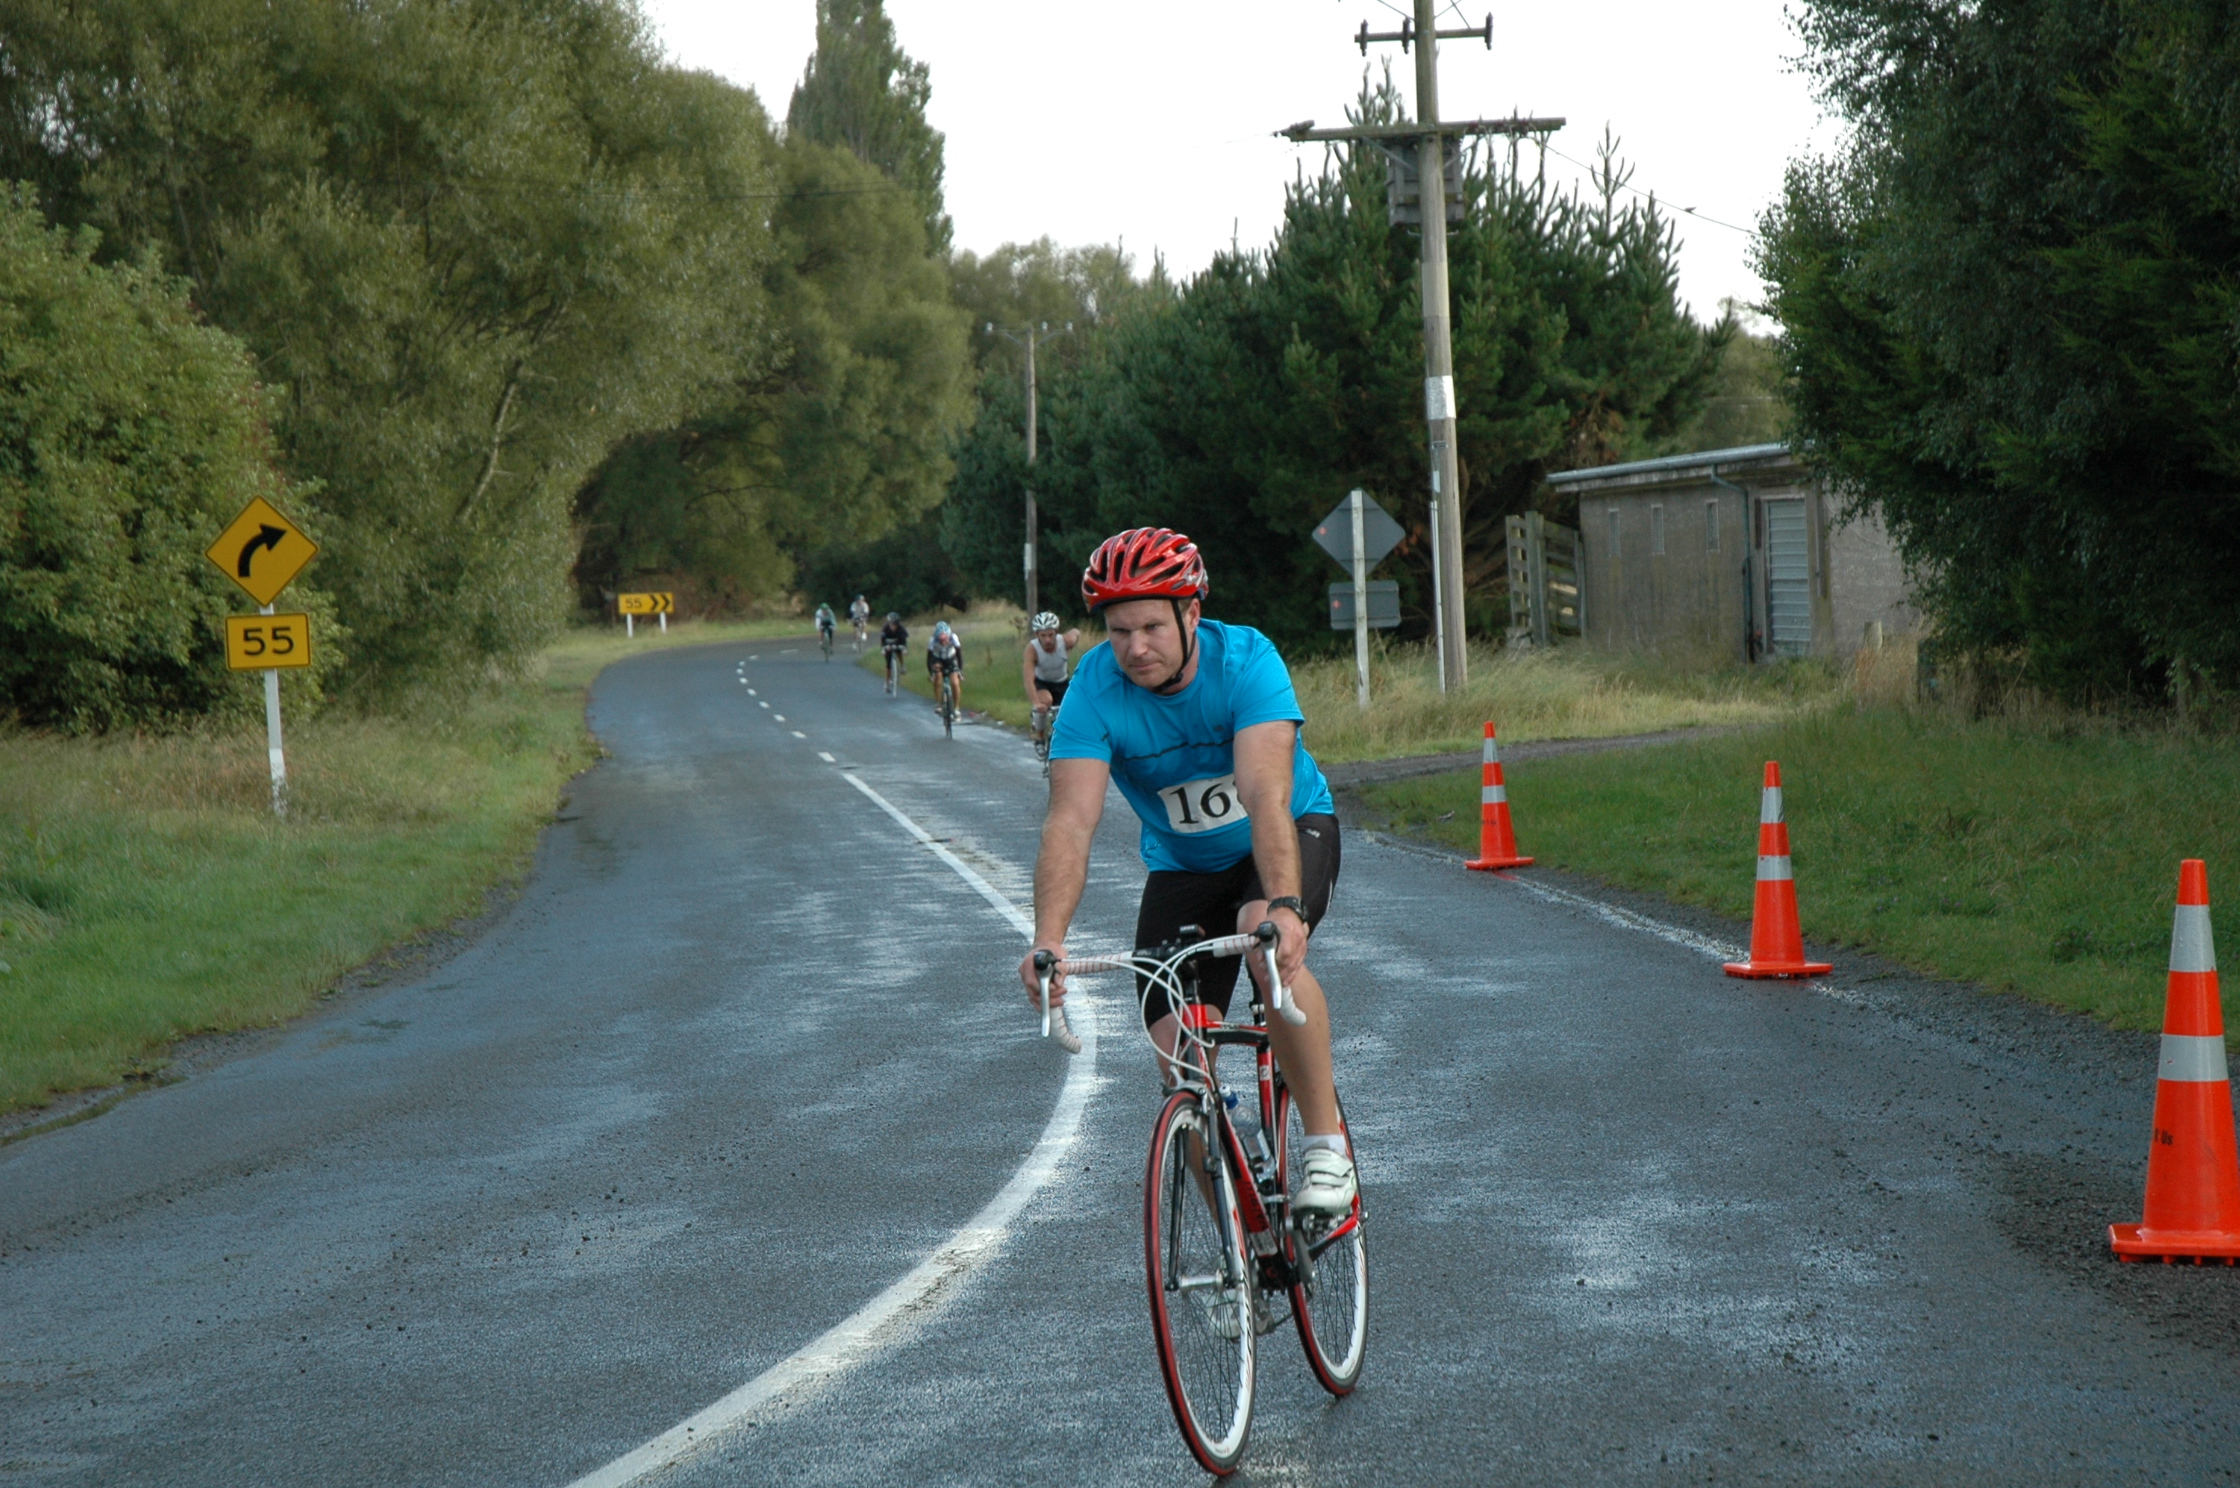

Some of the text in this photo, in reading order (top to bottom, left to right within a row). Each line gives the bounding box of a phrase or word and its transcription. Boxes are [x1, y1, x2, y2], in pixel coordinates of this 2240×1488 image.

[625, 597, 642, 609] 55
[243, 625, 294, 656] 55
[1169, 782, 1238, 825] 16
